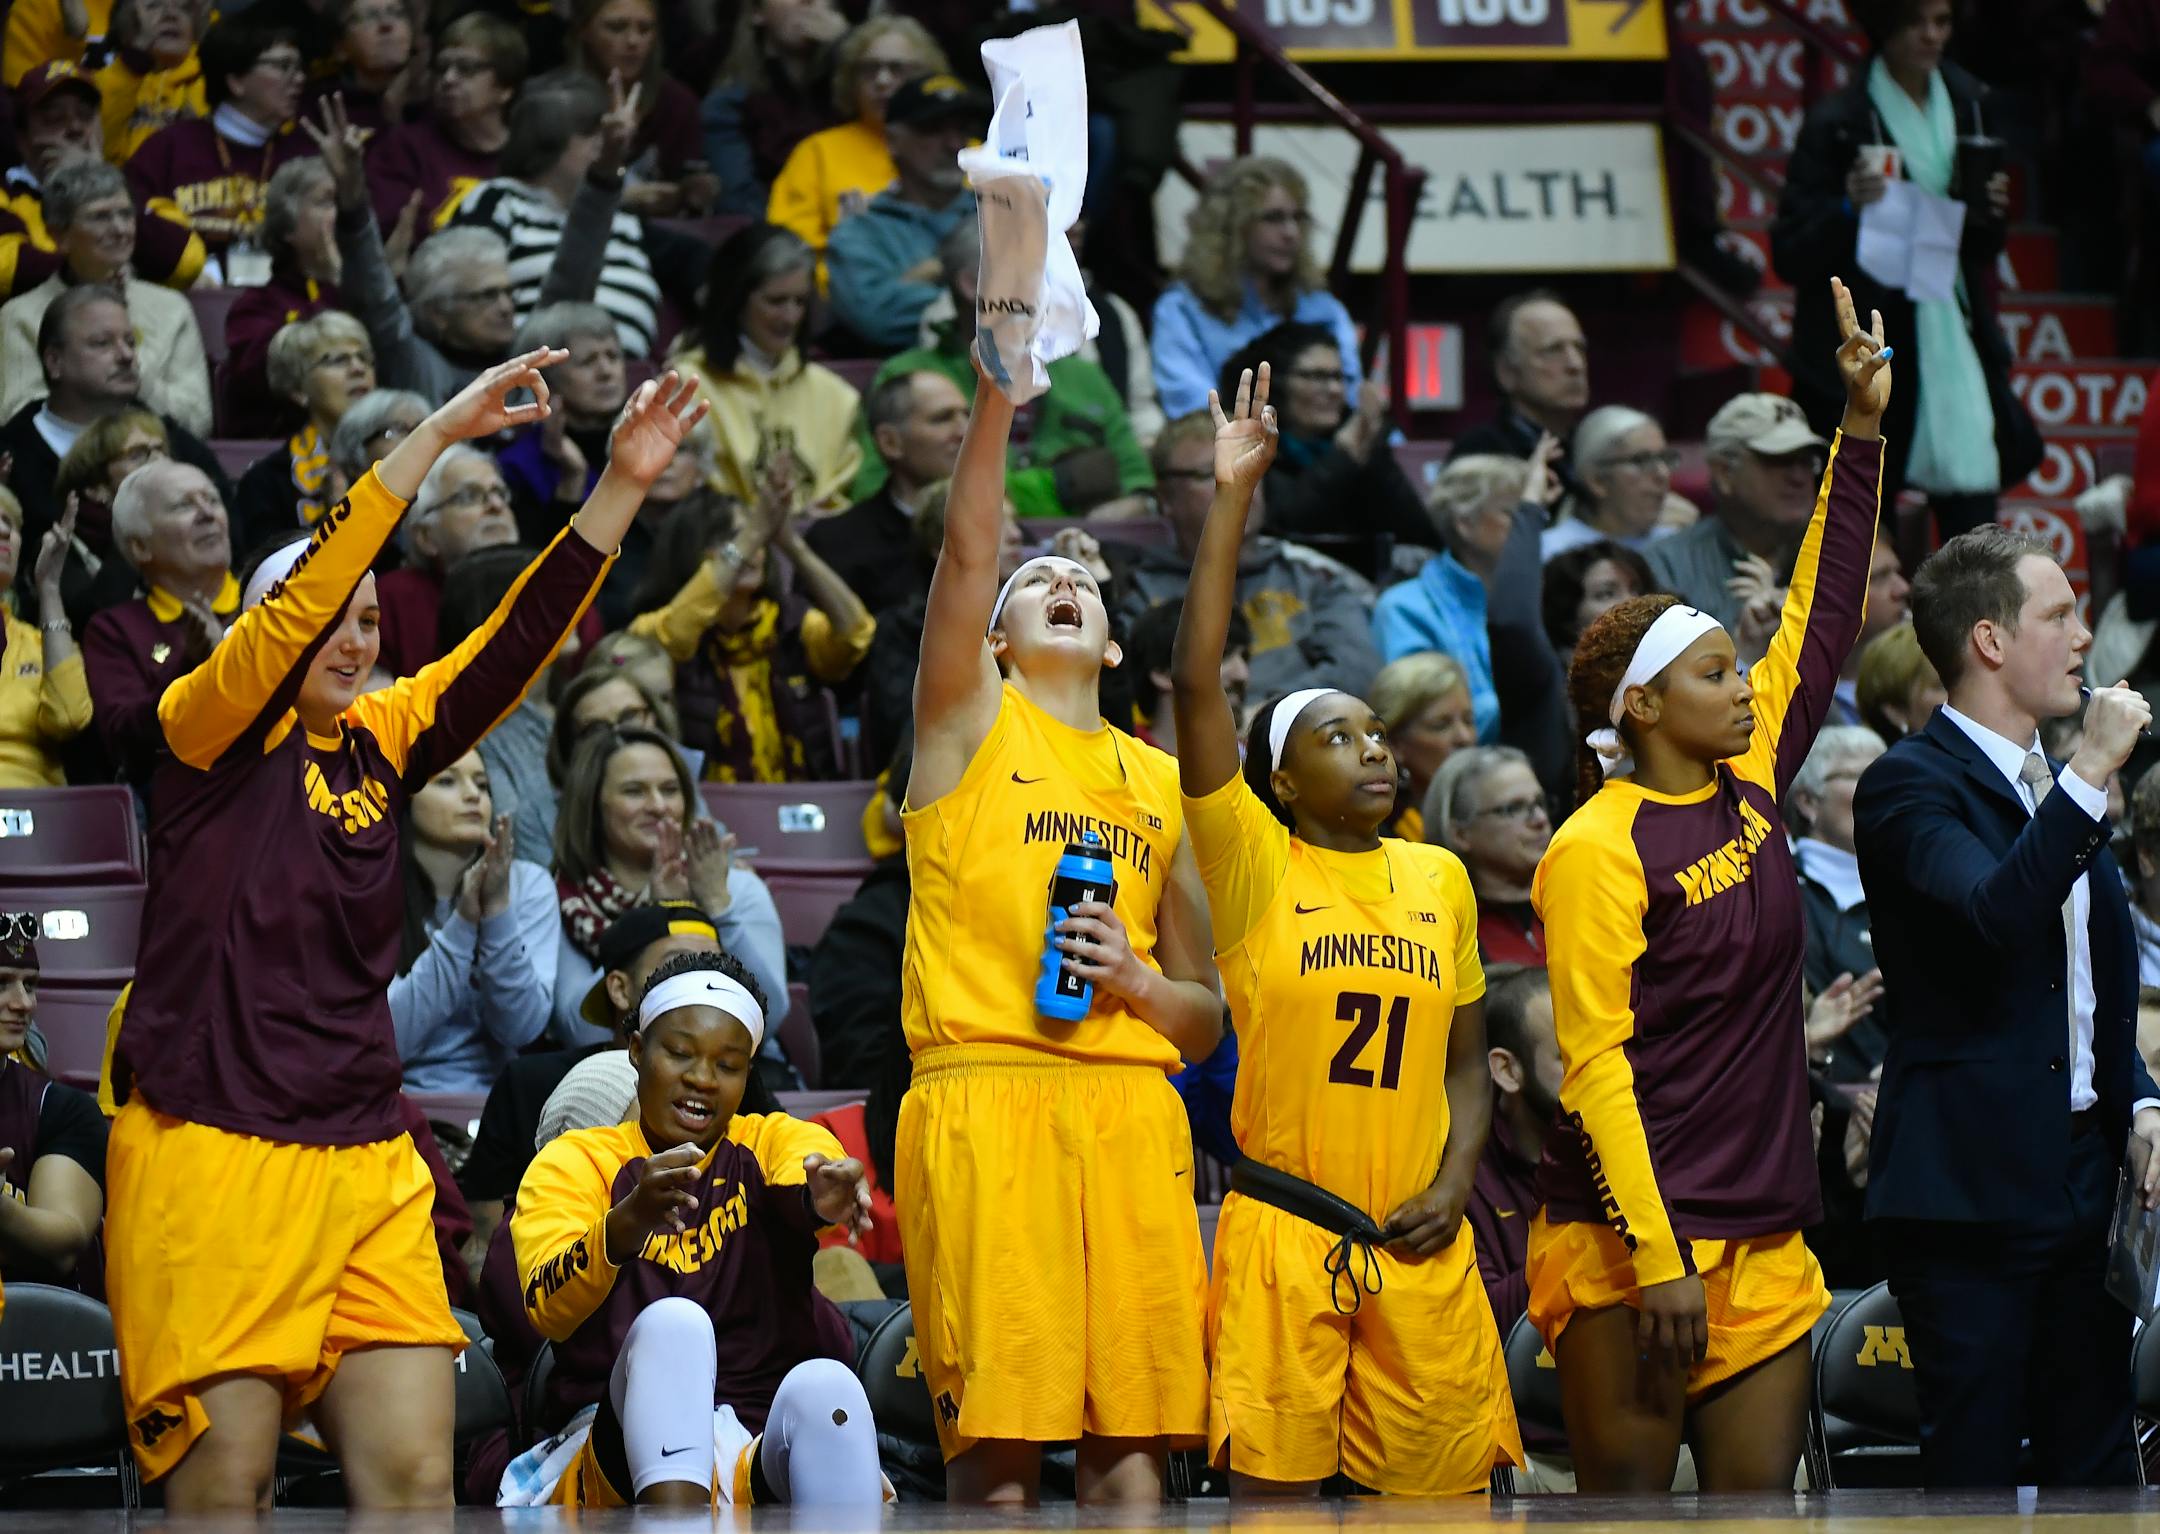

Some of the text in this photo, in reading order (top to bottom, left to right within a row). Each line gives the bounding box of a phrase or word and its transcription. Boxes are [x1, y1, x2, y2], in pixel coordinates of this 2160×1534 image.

[1368, 168, 1618, 220] EALTH
[1024, 810, 1151, 886] MINNESOTA
[1300, 932, 1441, 990] MINNESOTA
[1328, 991, 1410, 1091] 21
